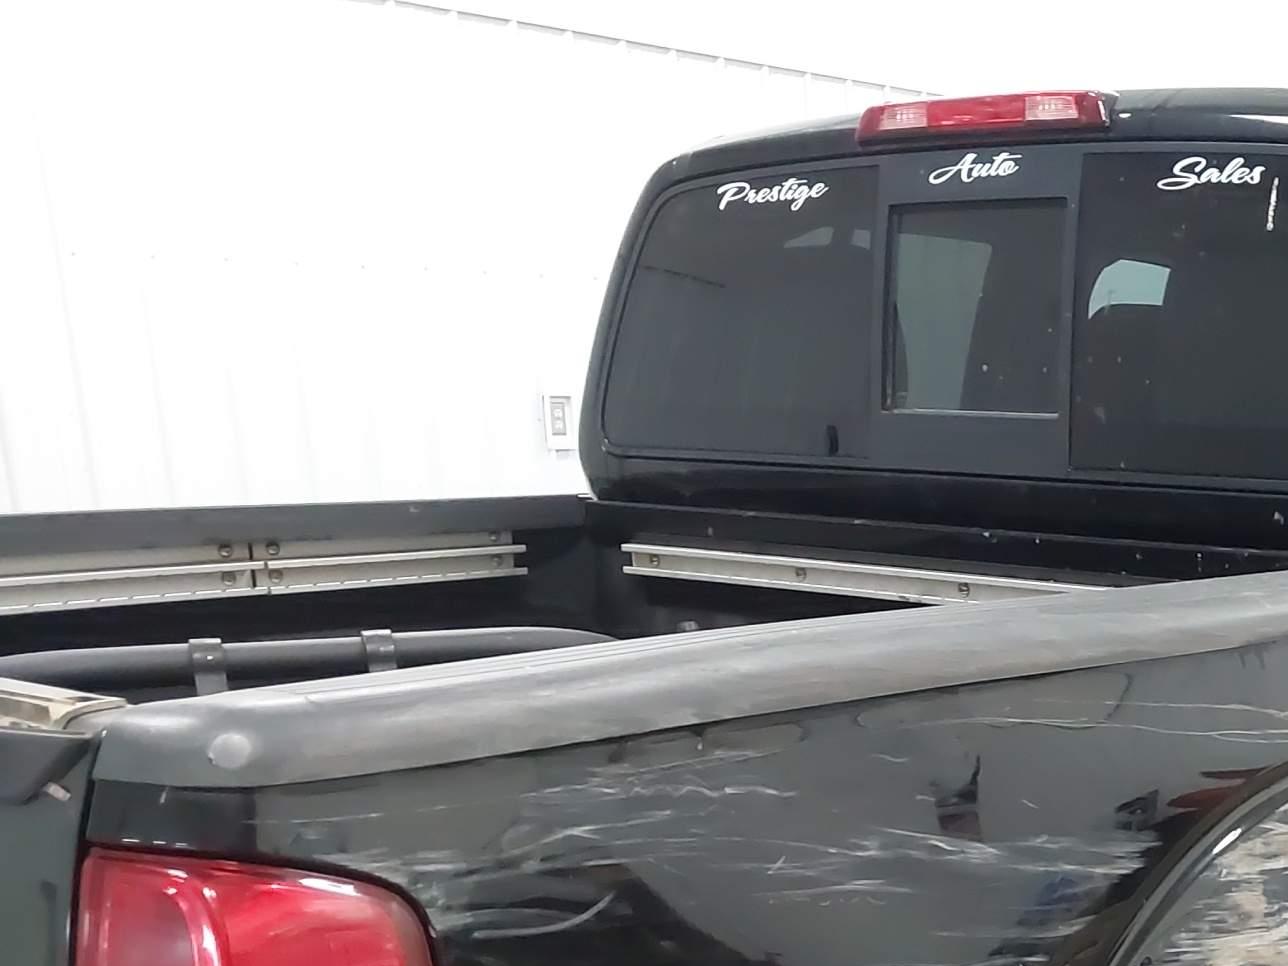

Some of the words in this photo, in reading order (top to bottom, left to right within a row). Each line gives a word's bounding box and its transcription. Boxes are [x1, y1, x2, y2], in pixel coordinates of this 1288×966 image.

[717, 178, 828, 210] Prestige
[929, 153, 1022, 184] Auto
[1157, 157, 1265, 190] Sales
